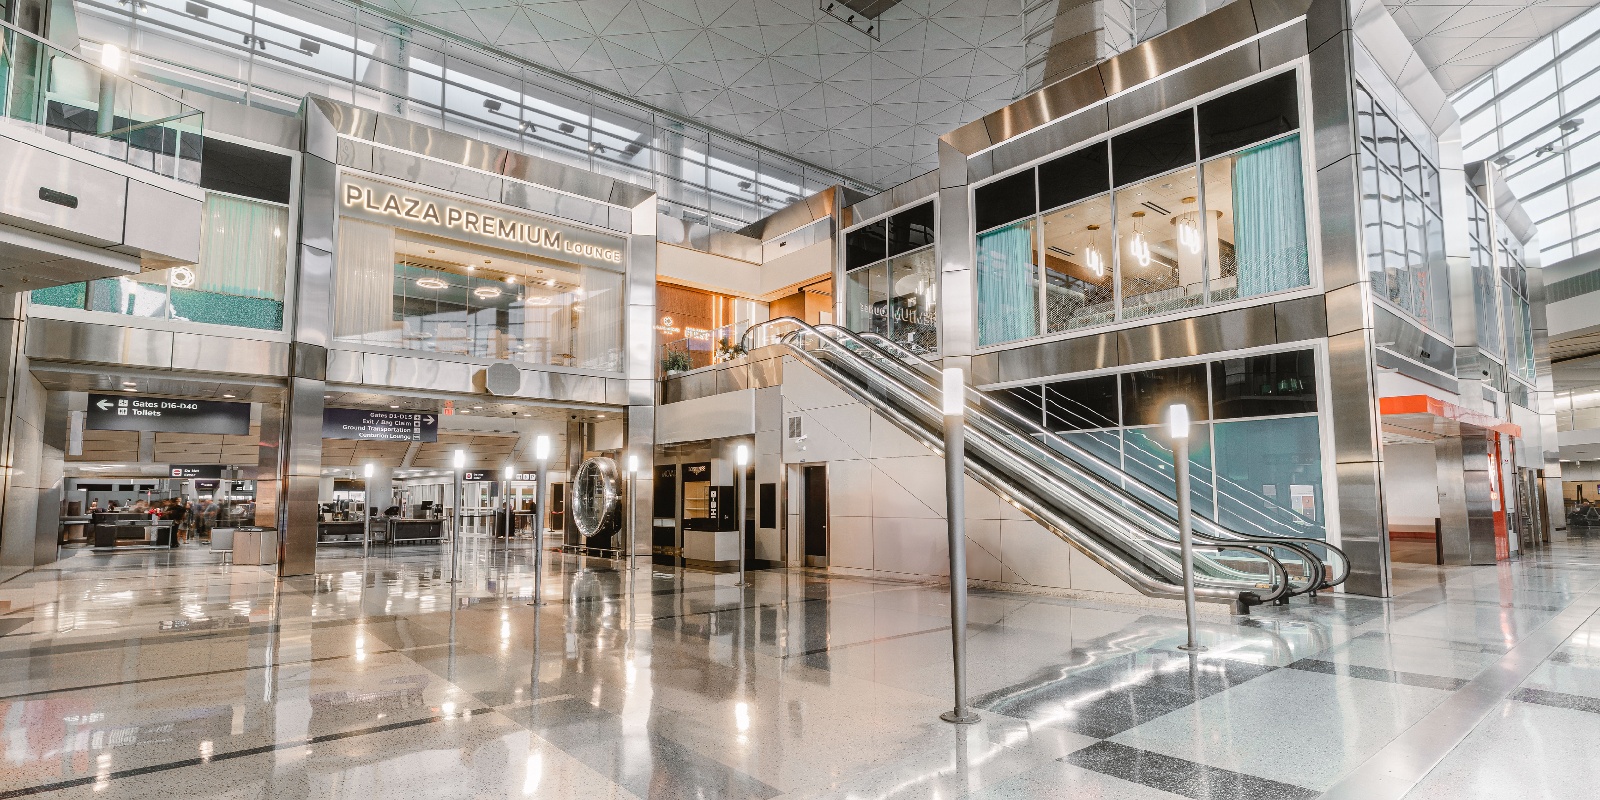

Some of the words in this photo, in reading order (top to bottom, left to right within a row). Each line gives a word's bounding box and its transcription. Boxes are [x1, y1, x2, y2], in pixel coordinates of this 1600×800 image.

[344, 184, 440, 224] PLAZA
[447, 207, 563, 249] PREMIUM
[565, 241, 621, 262] LOUNGE
[132, 400, 159, 408] Gates
[161, 402, 198, 410] D16-D40
[132, 408, 162, 417] Toilets
[381, 419, 393, 427] Bag
[367, 425, 411, 433] Transportation
